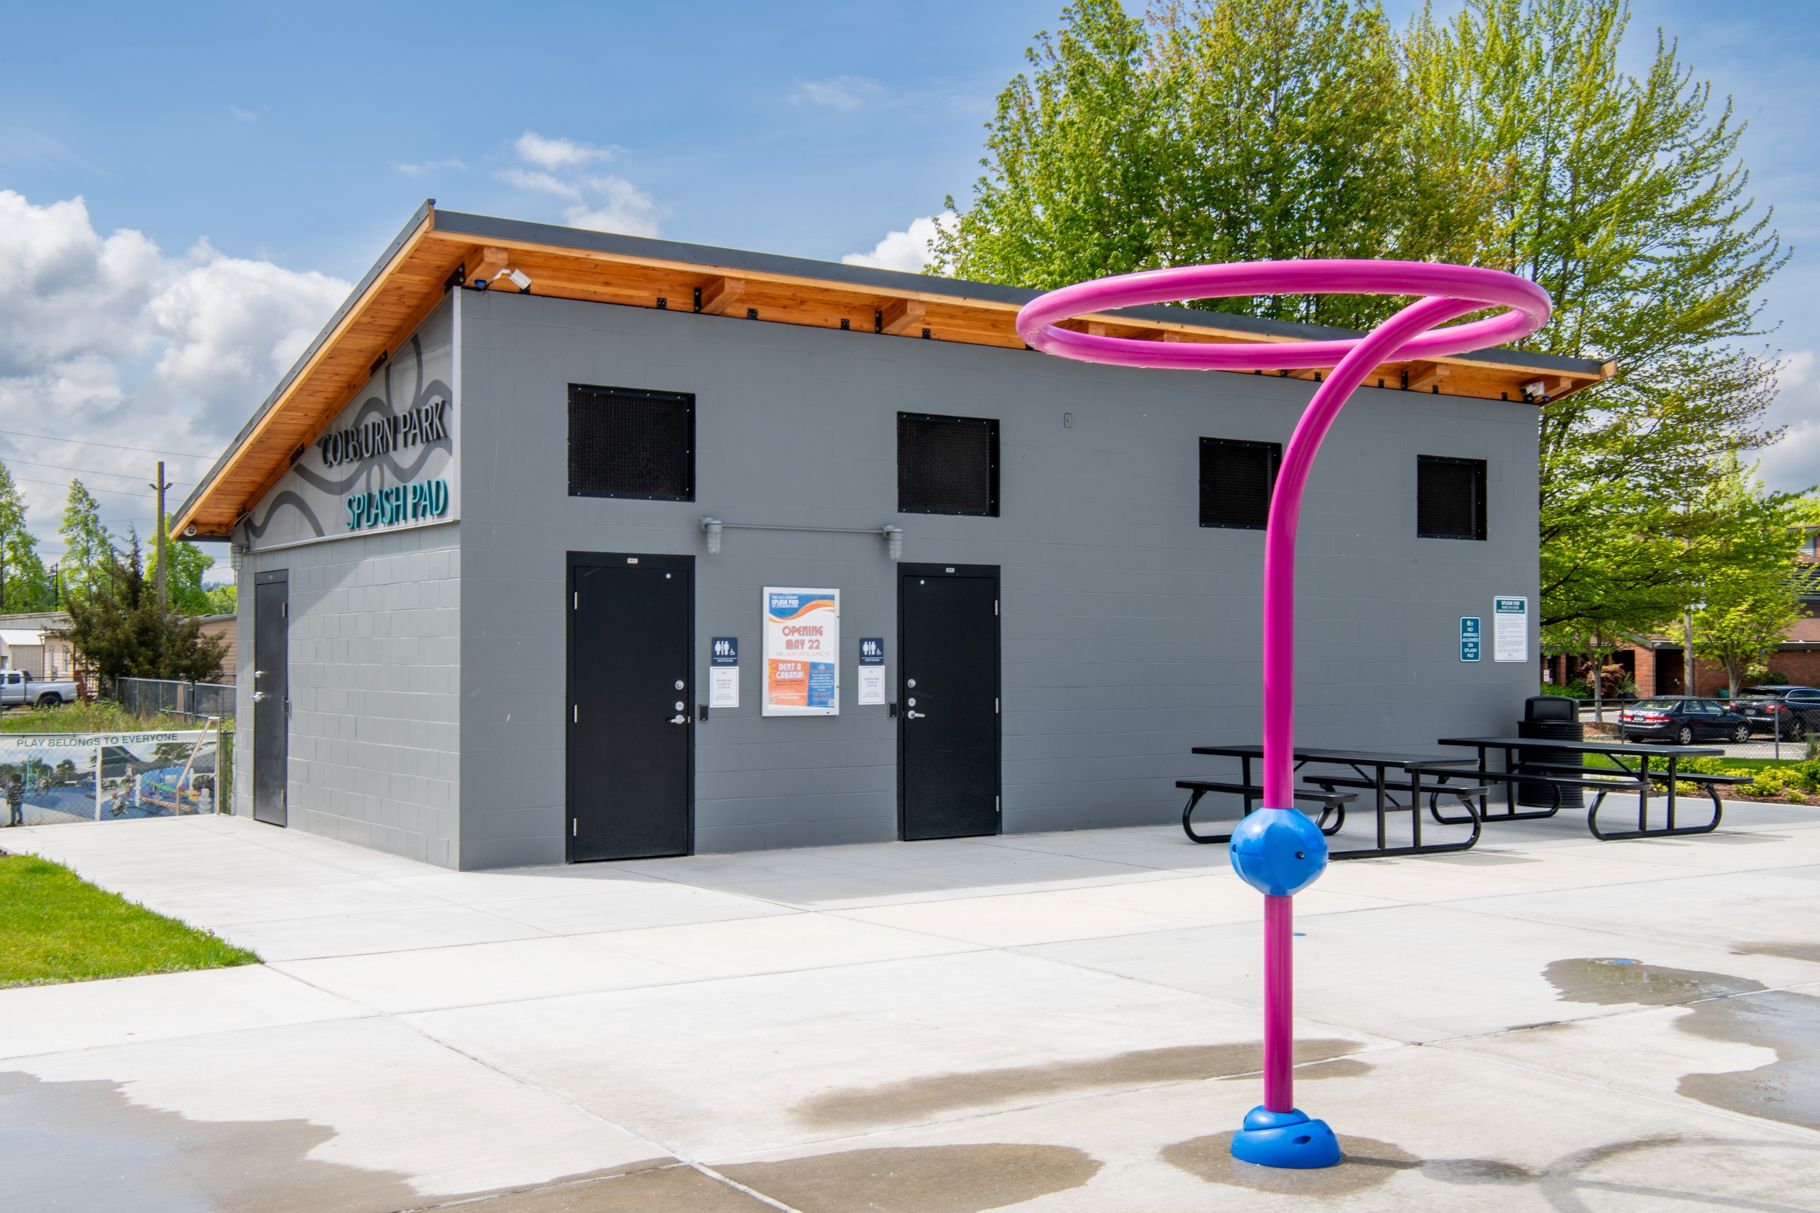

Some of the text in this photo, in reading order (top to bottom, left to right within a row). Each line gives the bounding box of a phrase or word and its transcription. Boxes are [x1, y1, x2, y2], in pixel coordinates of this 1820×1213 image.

[321, 400, 448, 468] COLBURN PARK
[345, 478, 449, 529] SPLASH PAD
[782, 625, 824, 637] OPENING
[785, 639, 821, 650] MAY 22
[778, 663, 795, 671] RENT
[796, 663, 802, 671] A
[16, 733, 178, 747] PLAY BELONGS TO EVERYONE
